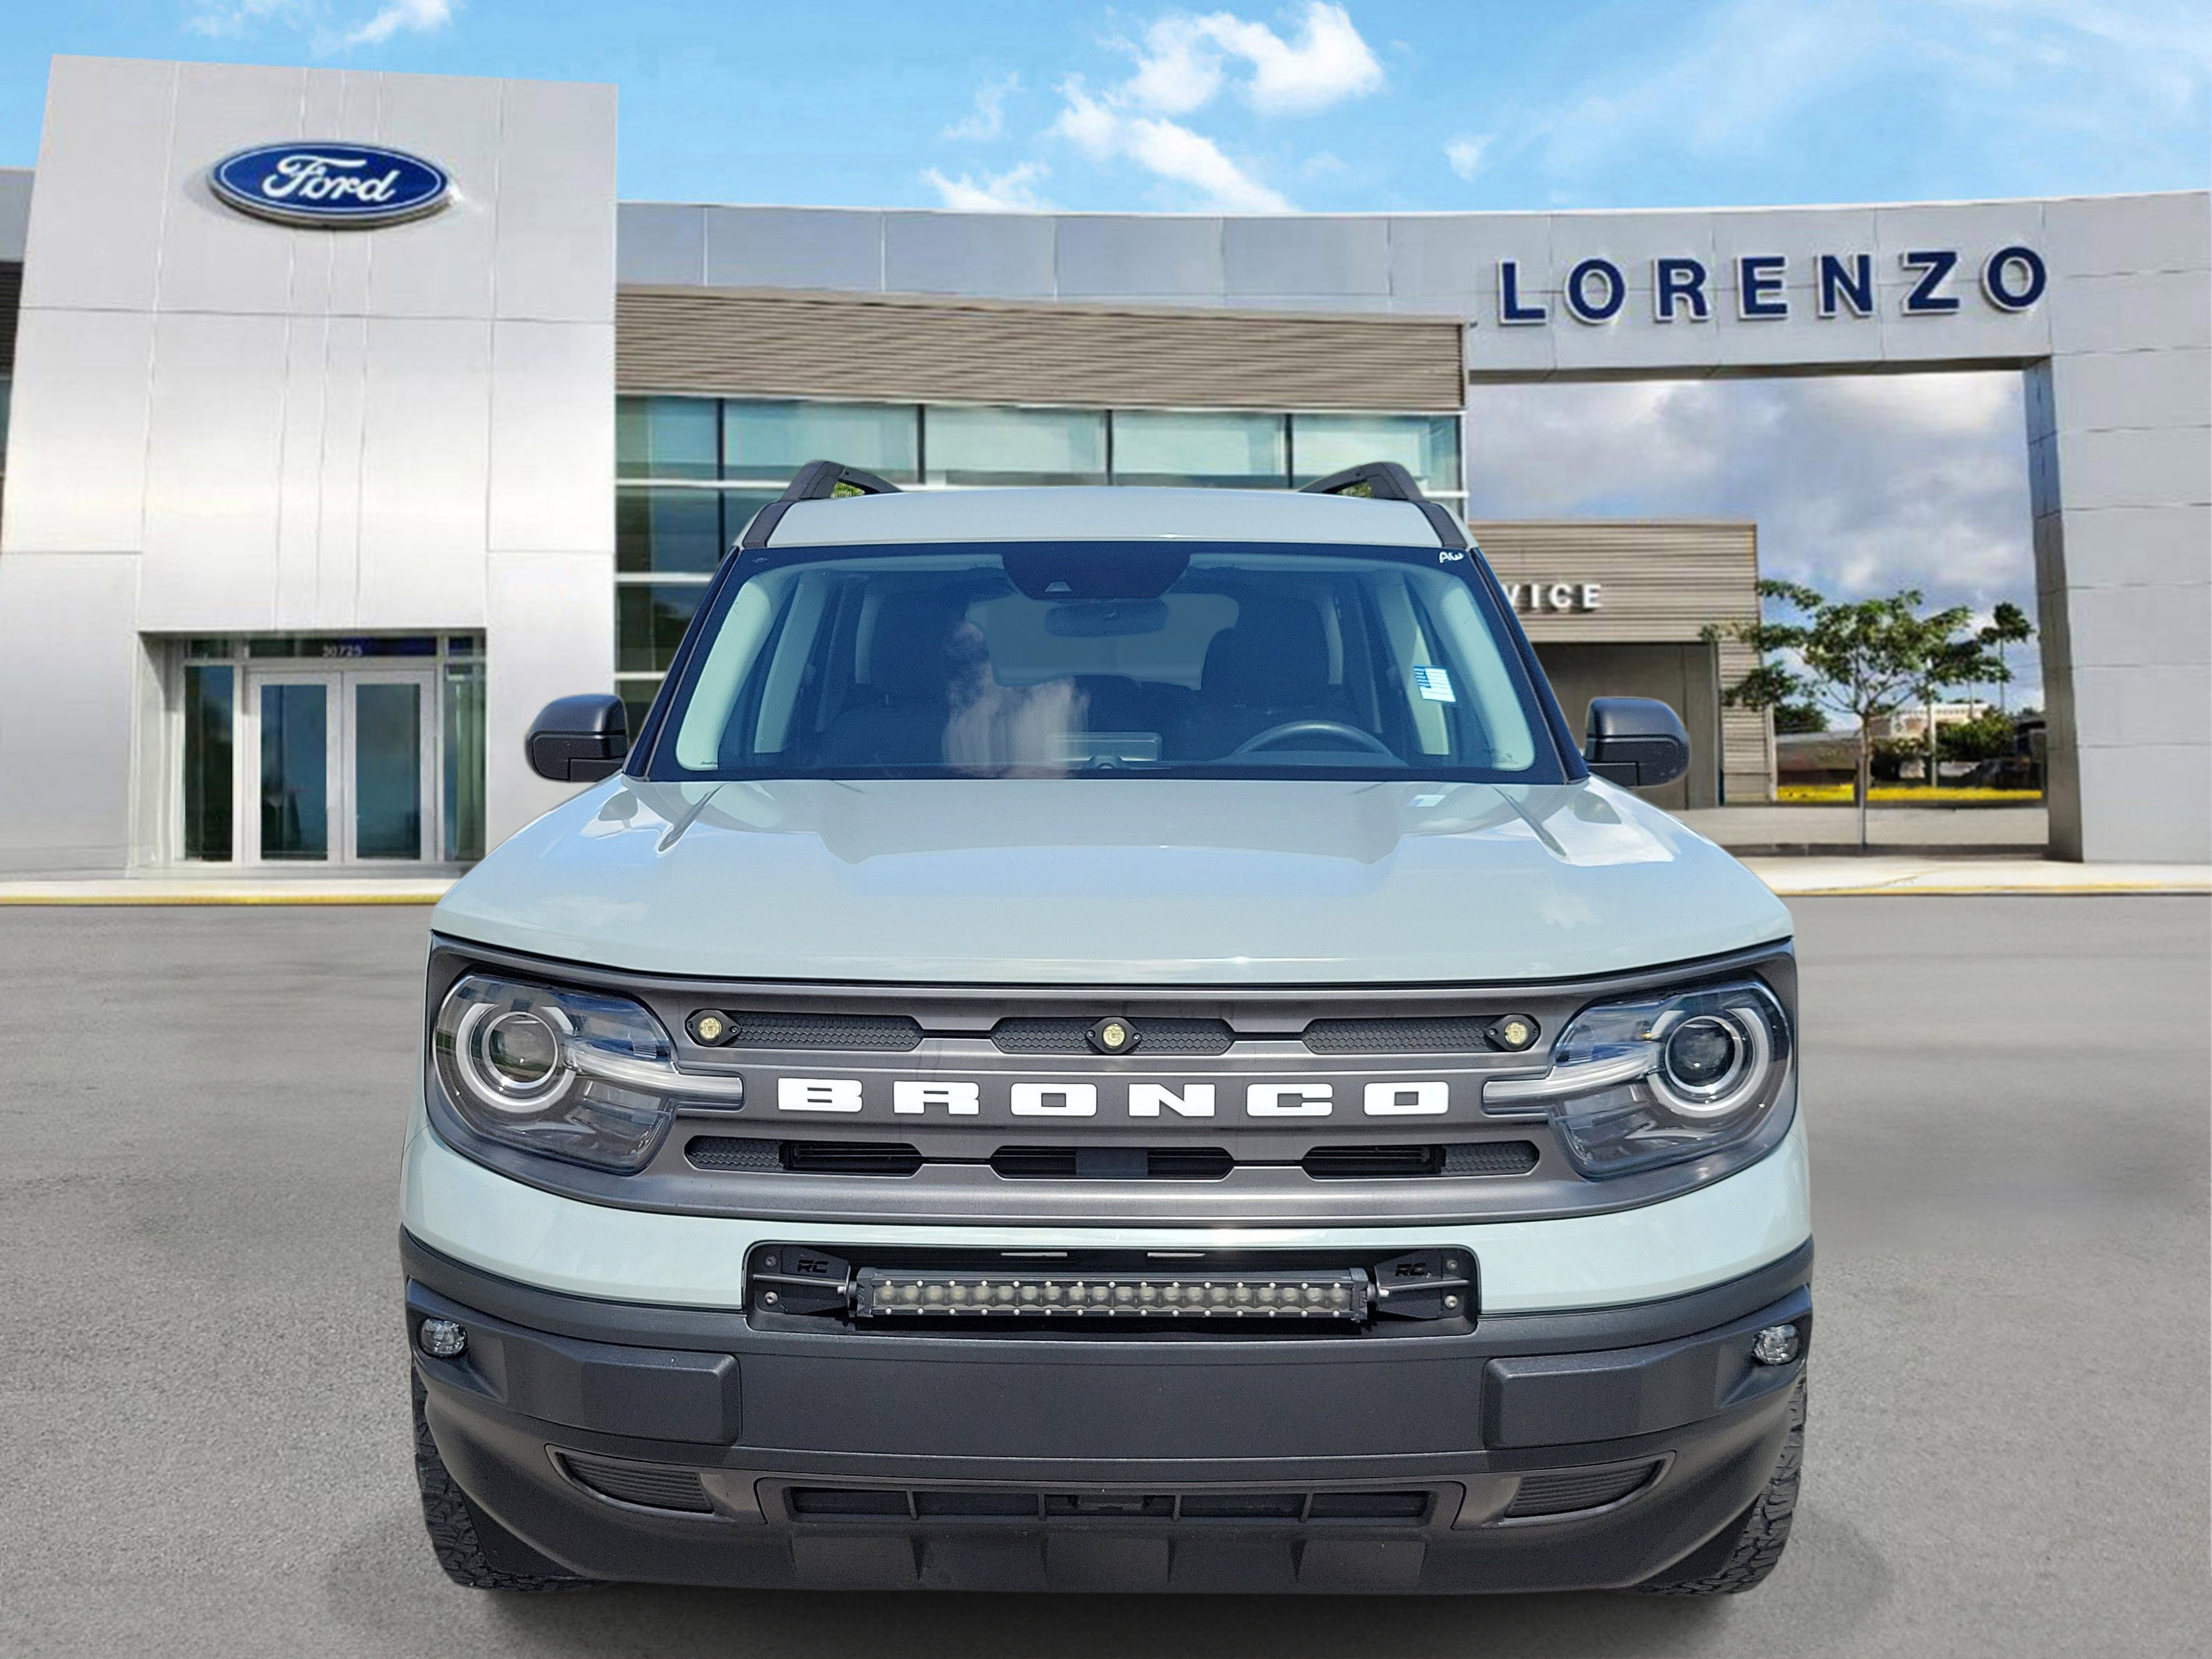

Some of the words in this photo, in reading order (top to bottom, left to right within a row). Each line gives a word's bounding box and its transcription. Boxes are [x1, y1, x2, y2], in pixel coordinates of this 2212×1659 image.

[262, 154, 401, 202] Ford
[1497, 246, 2047, 324] LORENZO
[778, 1077, 1450, 1117] BRONCO
[797, 1259, 829, 1273] RC
